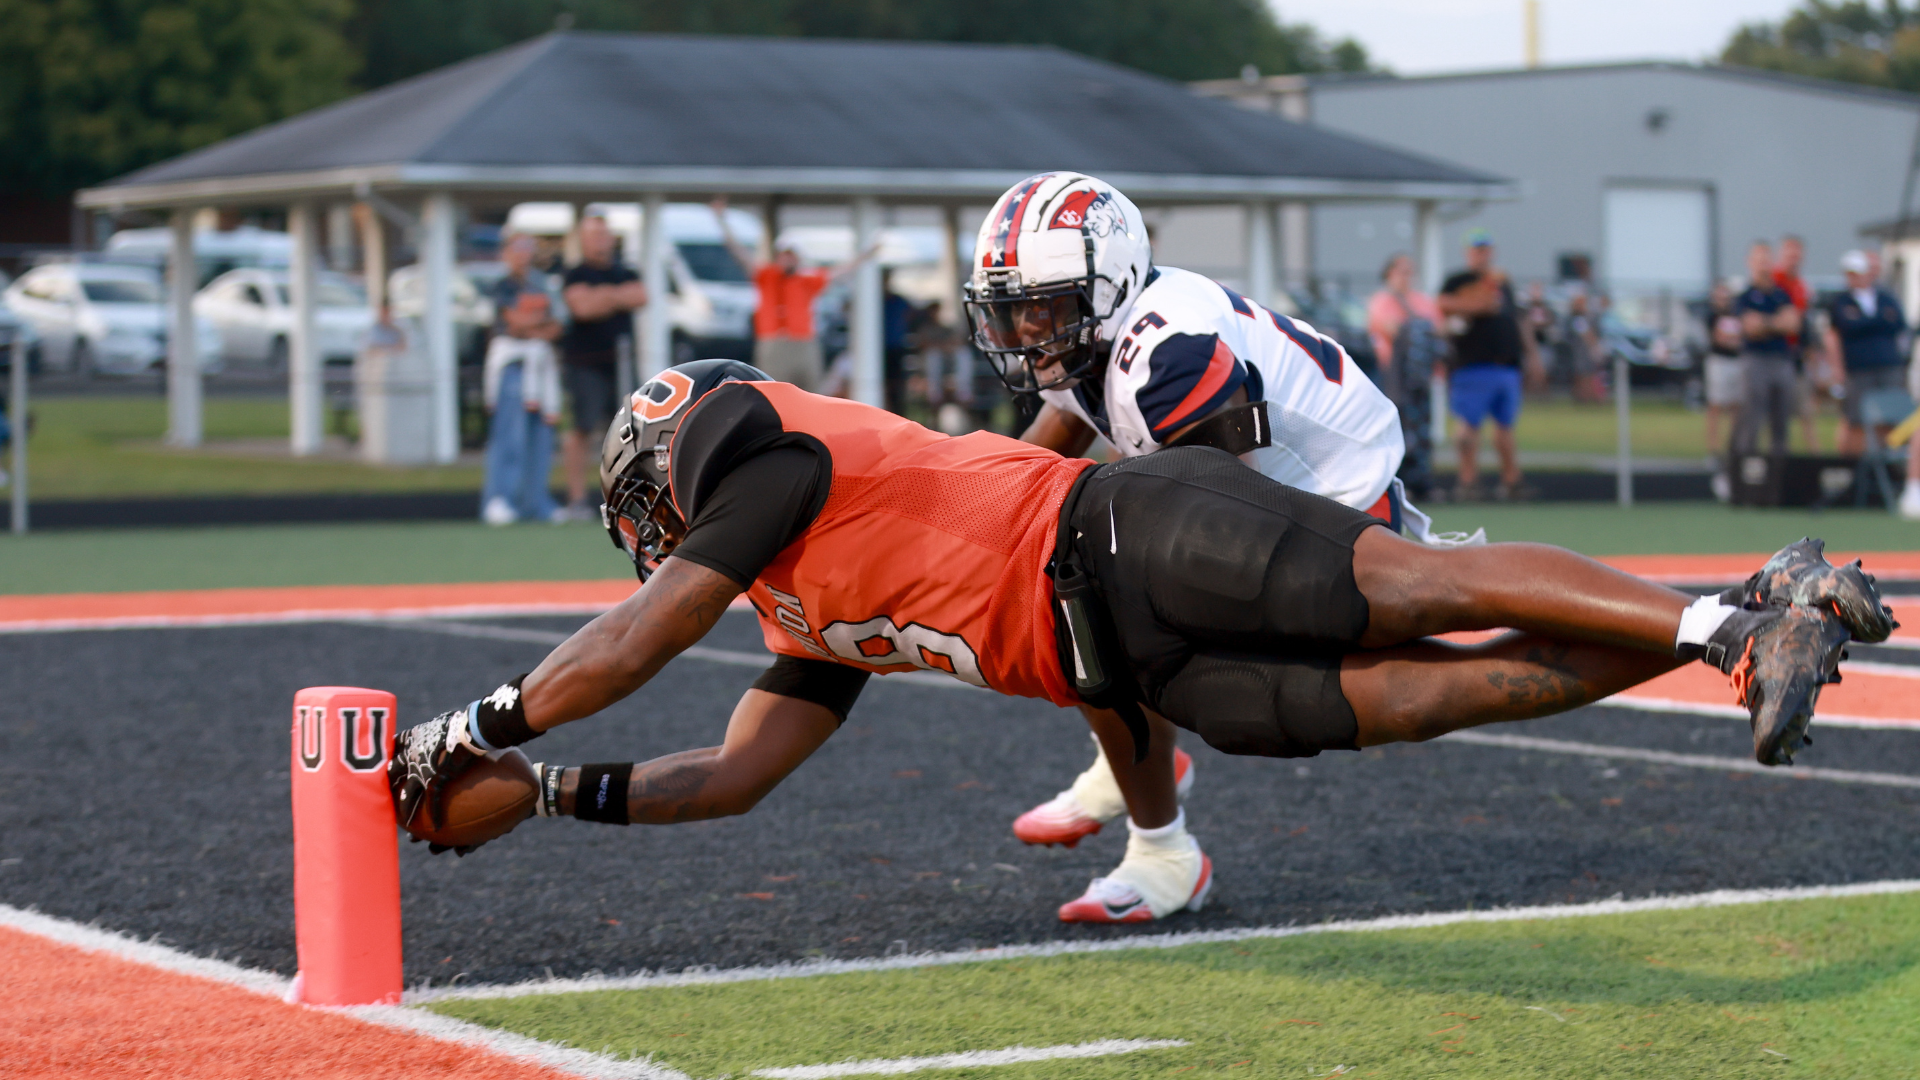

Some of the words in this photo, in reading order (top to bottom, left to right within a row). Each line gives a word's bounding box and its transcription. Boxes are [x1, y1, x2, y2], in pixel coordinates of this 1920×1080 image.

[1115, 311, 1168, 375] 29
[295, 705, 327, 773] U
[337, 706, 391, 774] U
